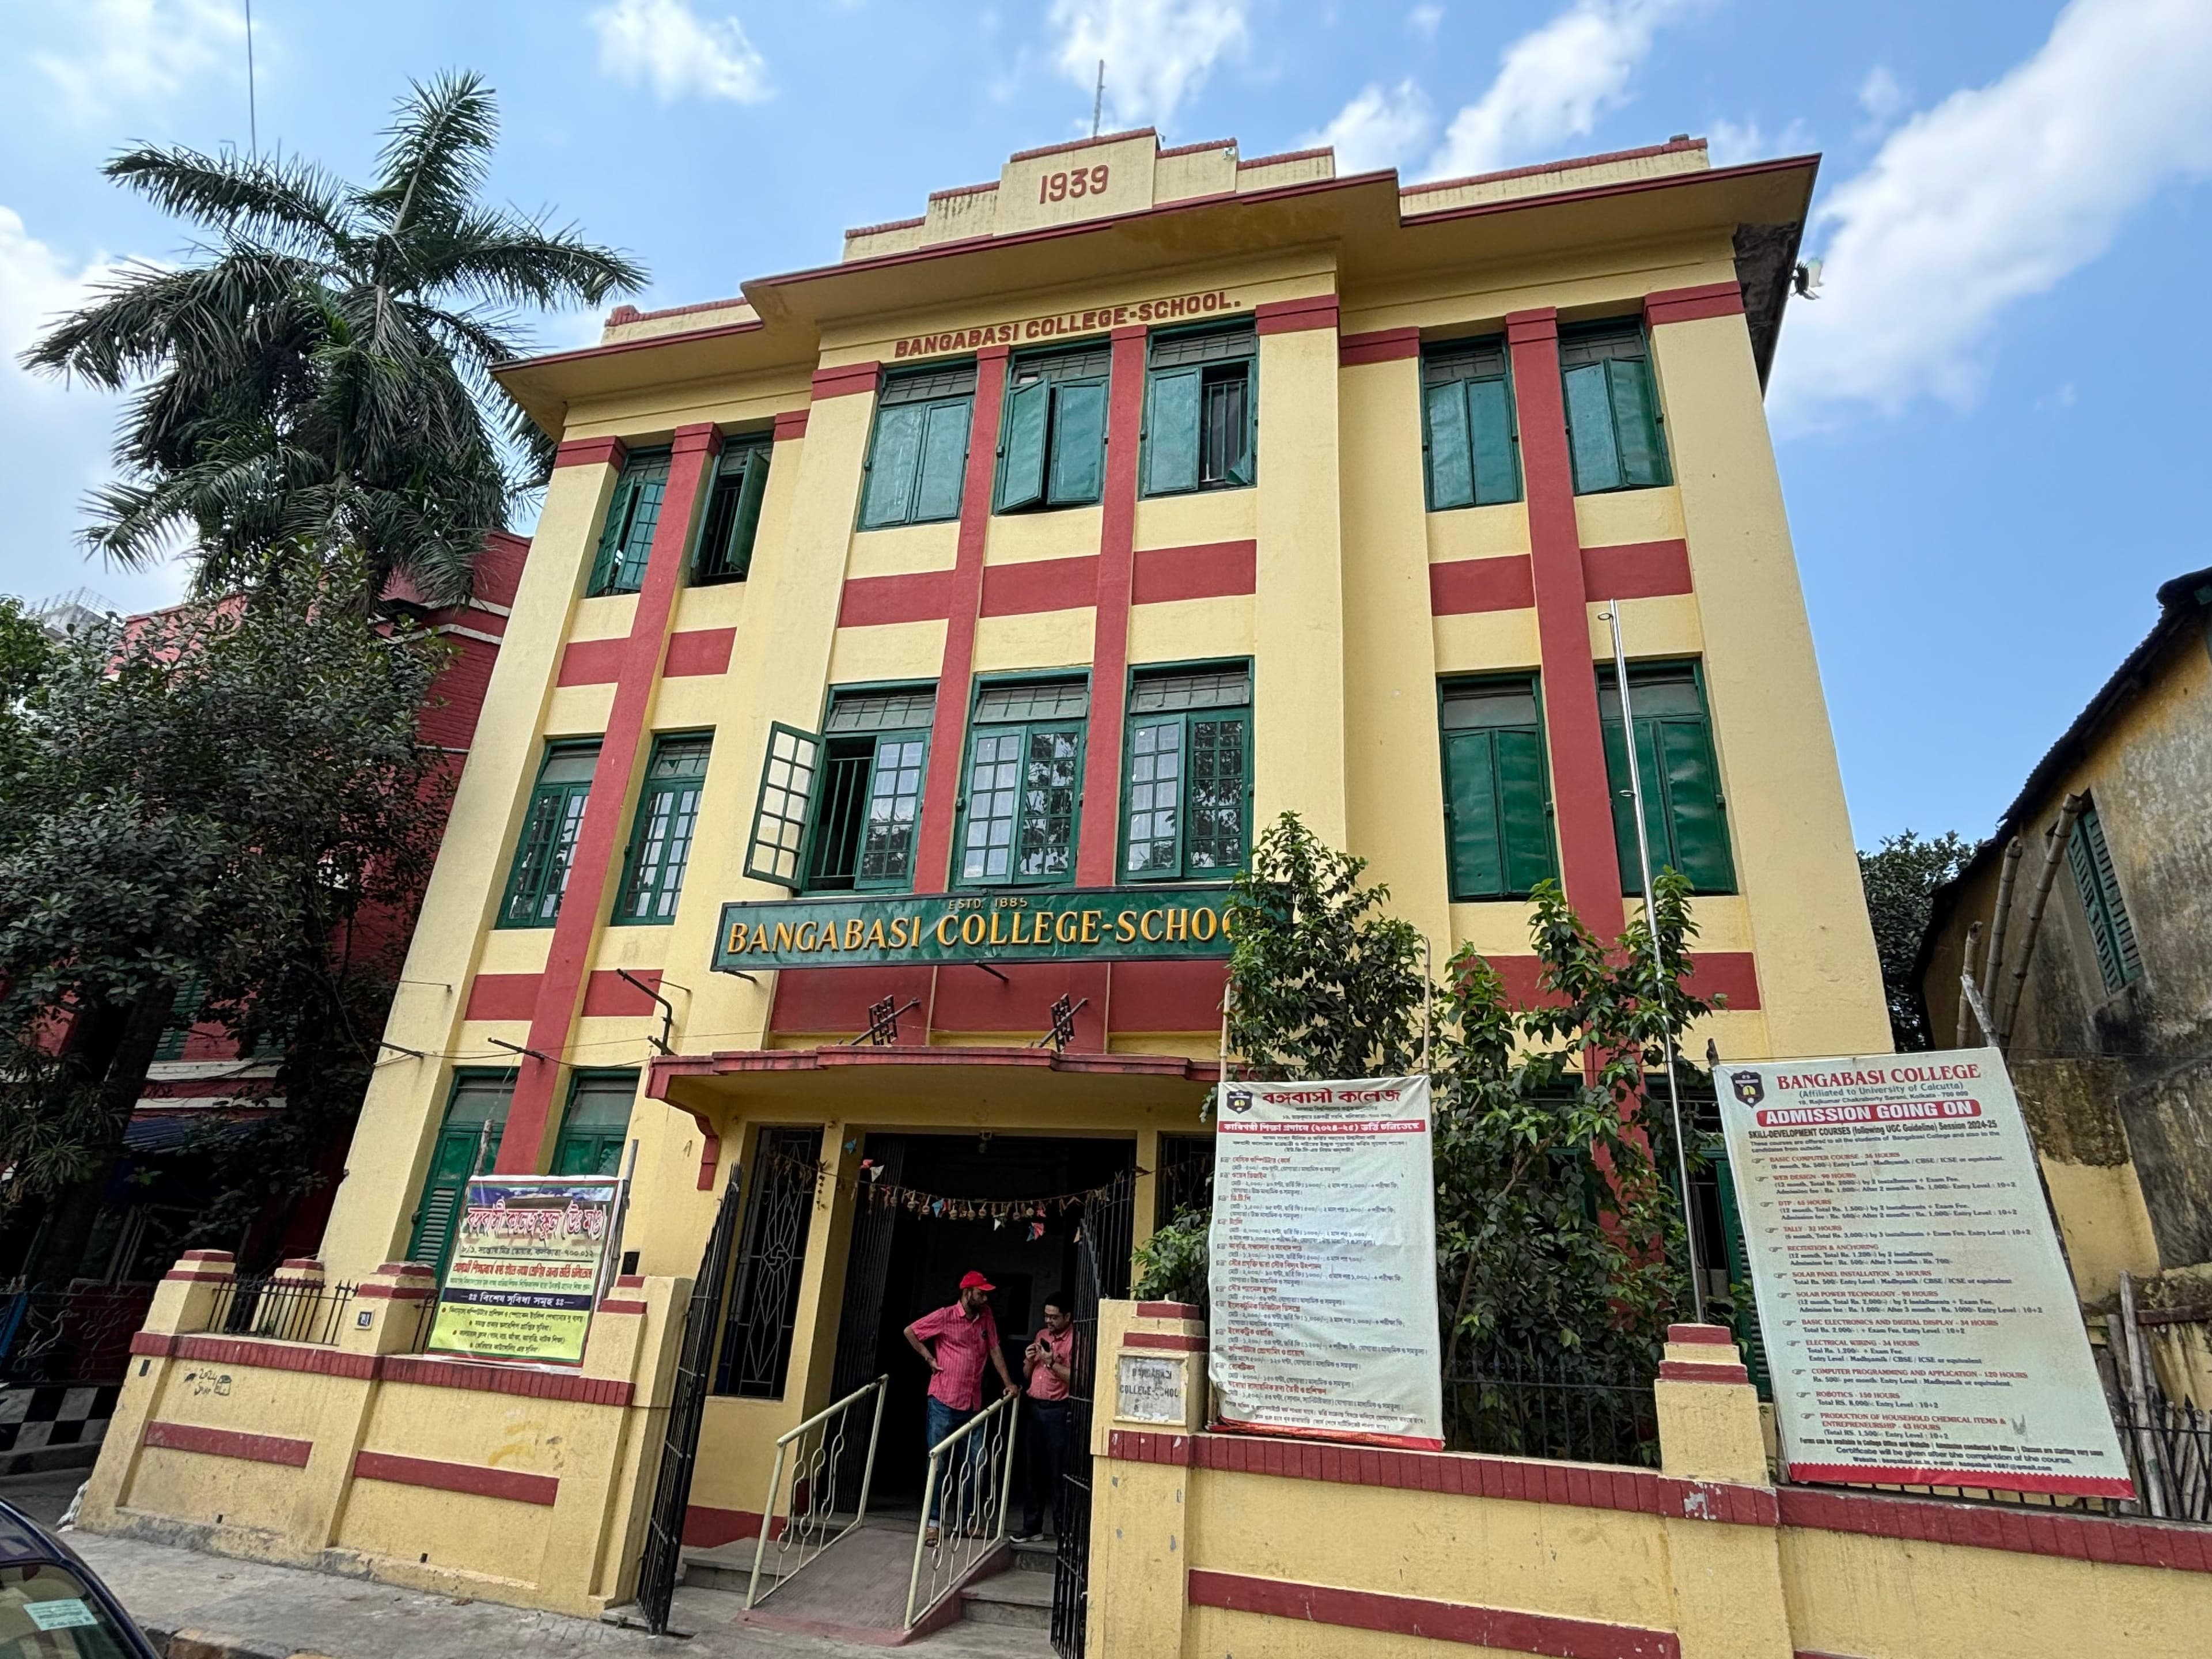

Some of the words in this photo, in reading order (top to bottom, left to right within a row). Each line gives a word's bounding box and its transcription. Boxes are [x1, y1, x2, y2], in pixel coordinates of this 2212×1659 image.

[1039, 165, 1109, 204] 1939
[895, 323, 1019, 358] BANGABASI
[1026, 291, 1240, 339] COLLEGE-SCHOOL.
[949, 899, 984, 910] ESTD.
[995, 897, 1028, 908] 1885
[728, 916, 921, 954] BANGABASI
[1776, 1069, 1886, 1090] BANGABASI
[1889, 1063, 1982, 1083] COLLEGE
[1262, 1088, 1332, 1106] বঙ্গবাসী
[1337, 1089, 1402, 1104] কলেজ
[1798, 1088, 1844, 1099] (Affiliated
[1858, 1085, 1905, 1095] University
[1919, 1081, 1964, 1091] Calcutta)
[1764, 1106, 1872, 1124] ADMISSION
[1875, 1102, 1939, 1119] GOING
[1942, 1100, 1973, 1115] ON
[1260, 1122, 1281, 1131] শিক্ষা
[1310, 1123, 1358, 1131] (২০২৪-২৫)
[1360, 1121, 1379, 1131] ভর্তি
[1748, 1128, 1817, 1139] SKILL-DEVELOPMENT
[1819, 1127, 1851, 1136] COURSES
[1851, 1125, 1885, 1136] (following
[1885, 1124, 1902, 1132] UGC
[1938, 1121, 1966, 1130] Session
[1966, 1119, 1997, 1128] 2024-25
[467, 1199, 506, 1233] বঙ্গবাসী
[539, 1210, 561, 1241] স্কুল
[479, 1291, 506, 1304] বিশেষ
[505, 1293, 532, 1306] সুবিধা
[1904, 1449, 1926, 1458] given
[1965, 1452, 2013, 1462] completion
